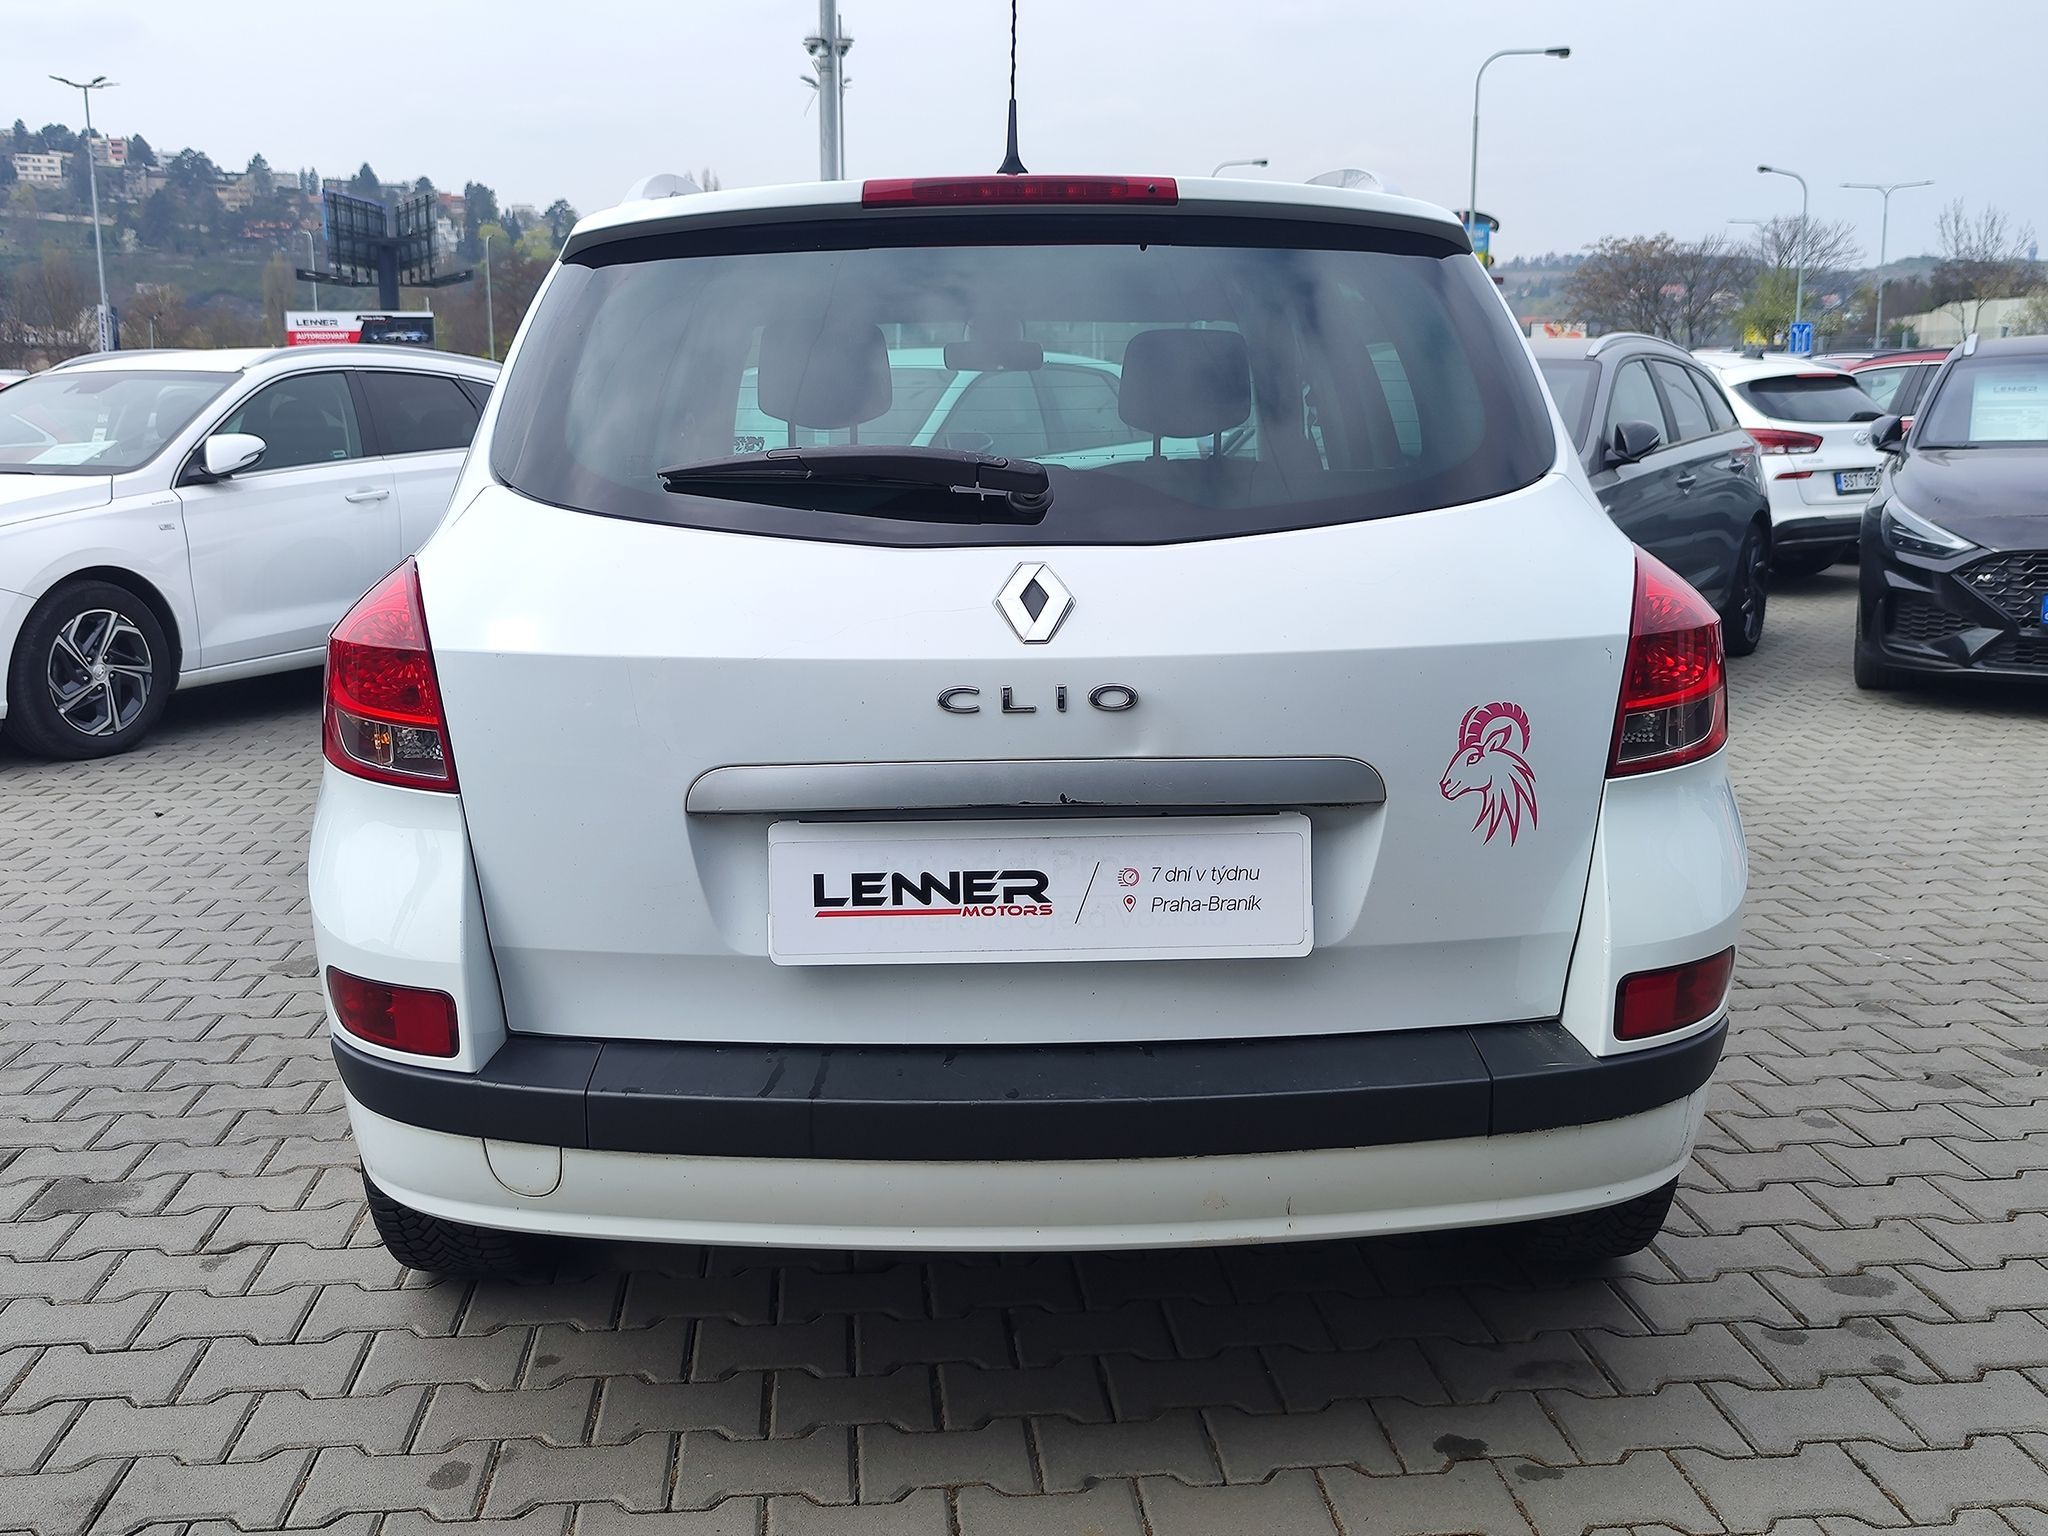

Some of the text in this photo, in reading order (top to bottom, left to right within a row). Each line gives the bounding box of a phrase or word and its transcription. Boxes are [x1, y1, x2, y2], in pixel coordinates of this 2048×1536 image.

[937, 683, 1139, 714] CLIO
[1151, 867, 1162, 882] 7
[1164, 866, 1193, 882] dní
[1196, 869, 1207, 882] v
[1211, 865, 1261, 885] týdnu
[813, 869, 1053, 908] LENNER
[962, 904, 1054, 917] MOTORS
[1151, 894, 1262, 913] Praha-Braník
